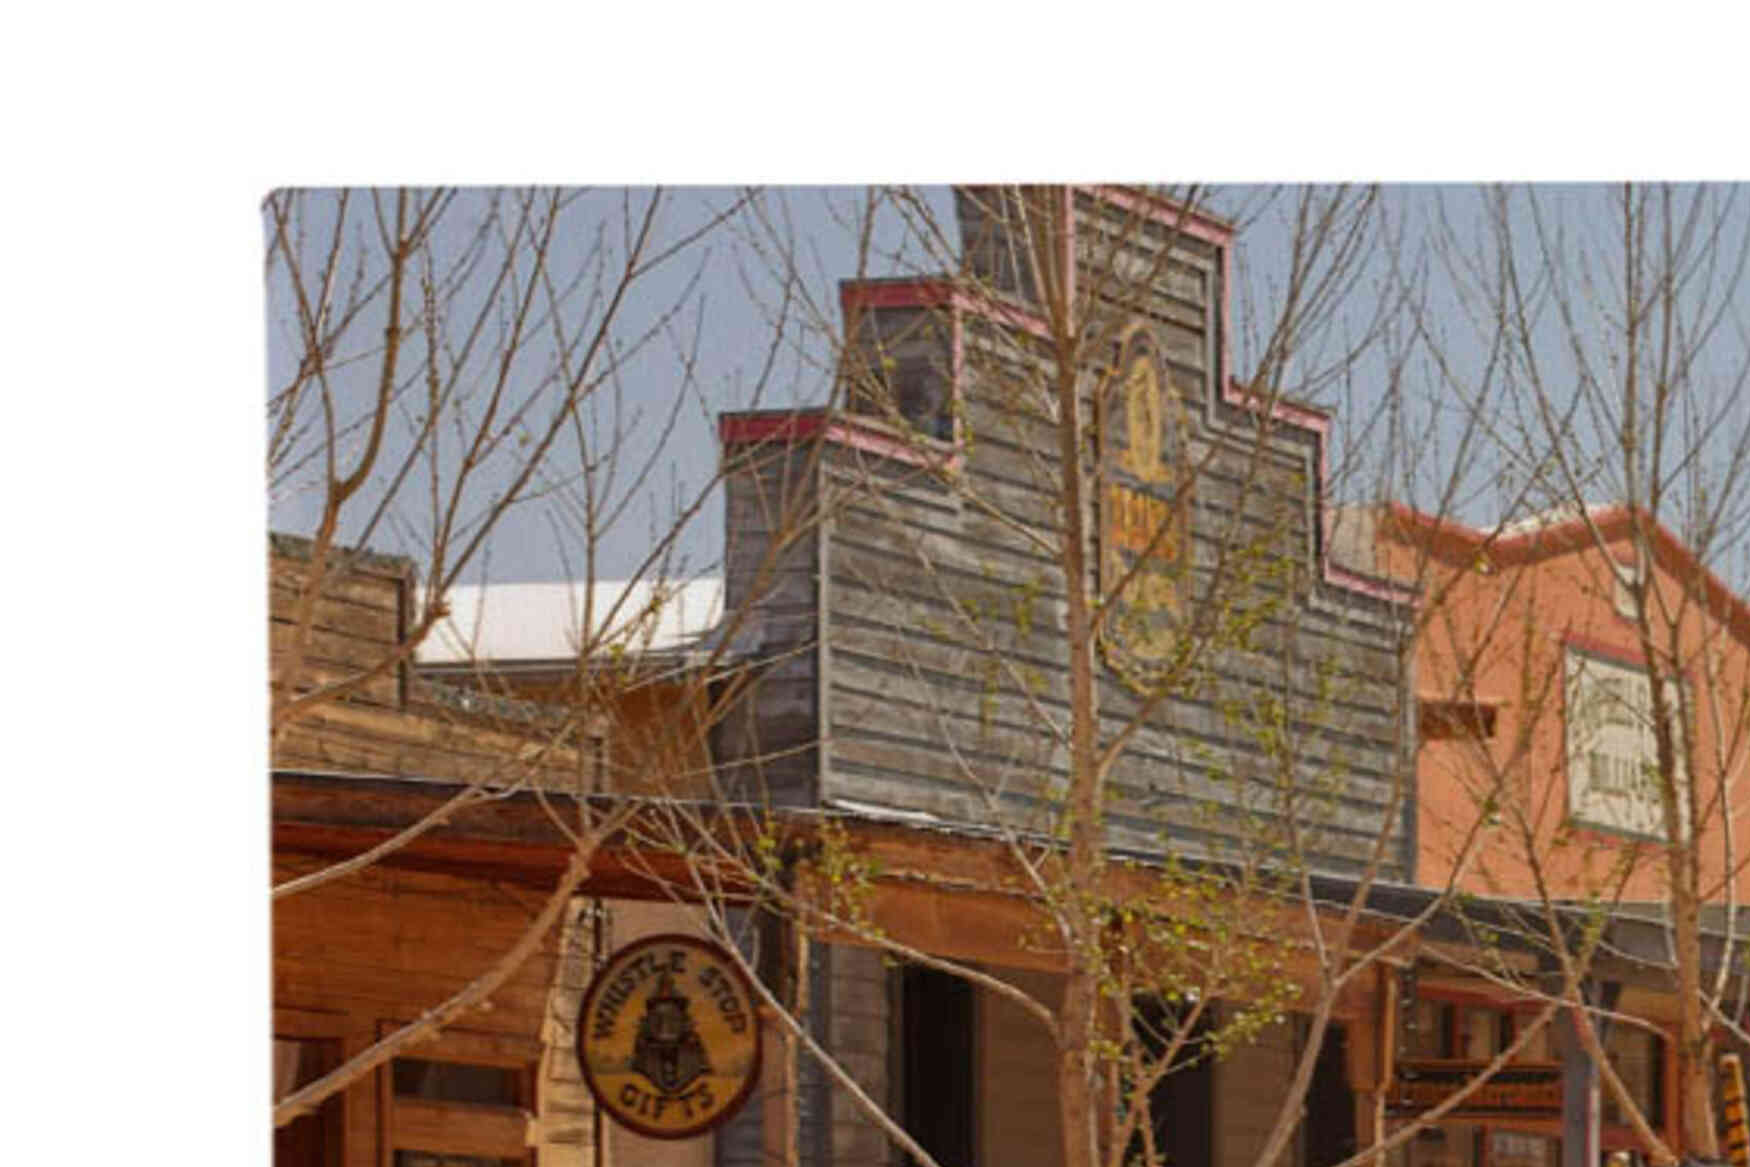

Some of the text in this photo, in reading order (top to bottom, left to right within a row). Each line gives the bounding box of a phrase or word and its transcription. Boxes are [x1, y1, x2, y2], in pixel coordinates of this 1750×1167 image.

[593, 950, 747, 1041] WHISTLE STOP
[619, 1081, 716, 1119] GIFTS
